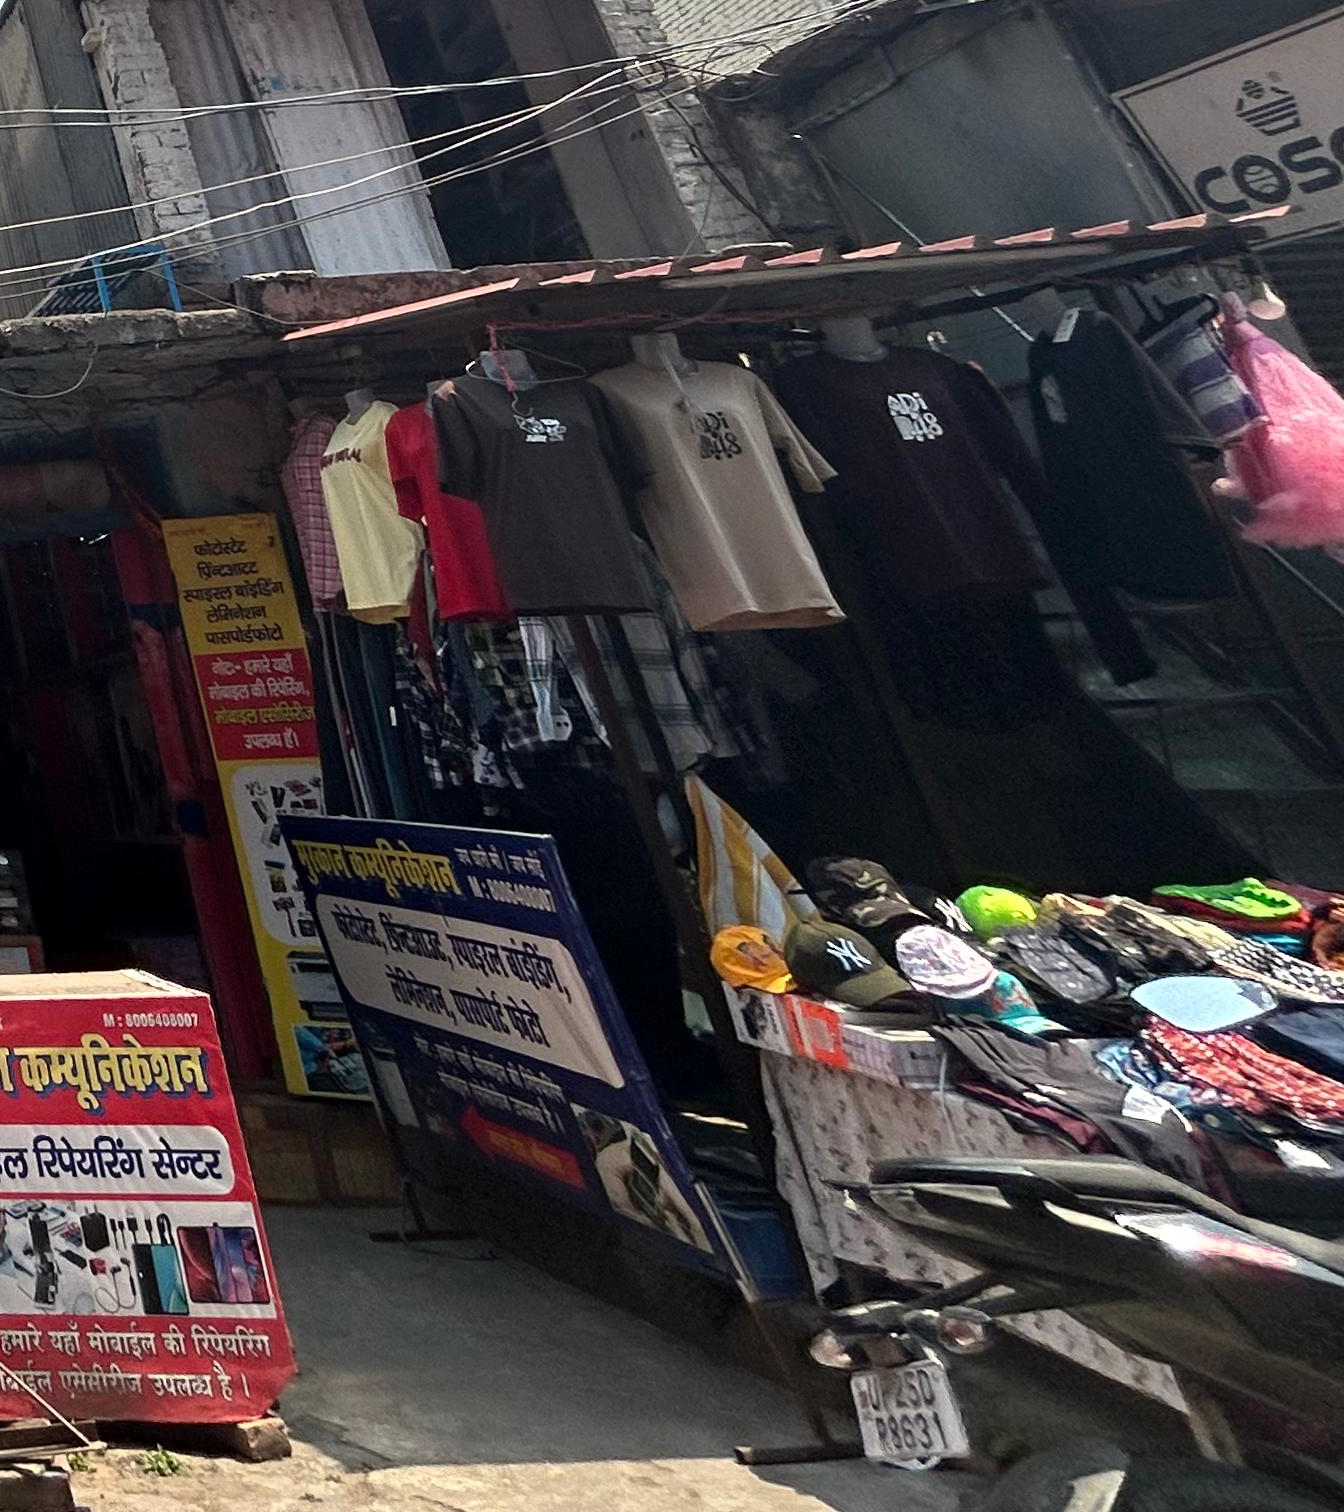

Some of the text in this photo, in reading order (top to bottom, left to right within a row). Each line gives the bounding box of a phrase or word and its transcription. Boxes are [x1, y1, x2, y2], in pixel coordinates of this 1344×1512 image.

[13, 1033, 210, 1110] कम्यूनिकेशन
[33, 1134, 146, 1181] रिपेयरिंग
[149, 1137, 223, 1180] सेन्टर
[0, 1323, 43, 1355] हमारे
[47, 1320, 81, 1355] यहाँ
[86, 1323, 157, 1359] मोबाईल
[164, 1324, 188, 1356] की
[190, 1324, 272, 1359] रिपेयरिंग
[148, 1371, 213, 1398] उपलब्ध
